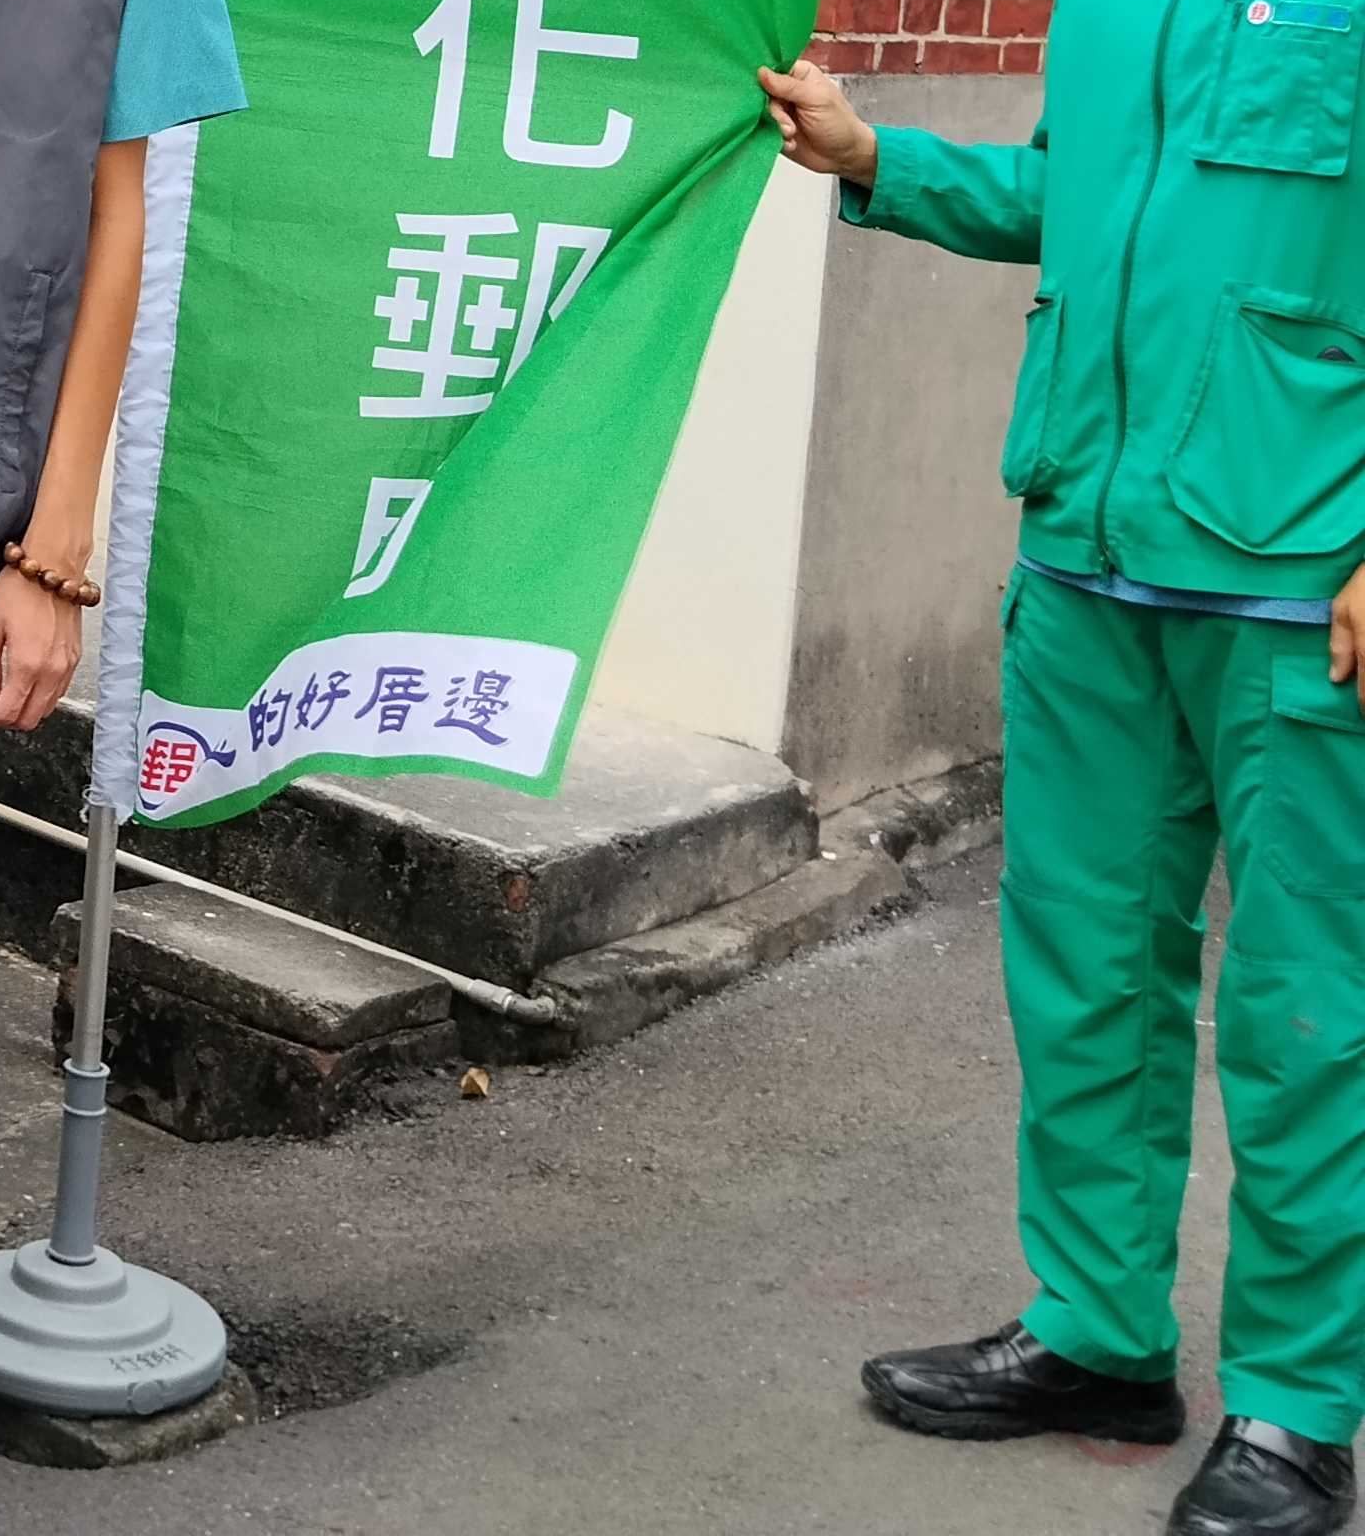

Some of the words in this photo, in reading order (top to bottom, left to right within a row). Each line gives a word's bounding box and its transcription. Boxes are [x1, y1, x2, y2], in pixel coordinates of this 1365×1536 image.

[139, 738, 198, 794] 郵
[206, 666, 512, 767] 的好厝邊
